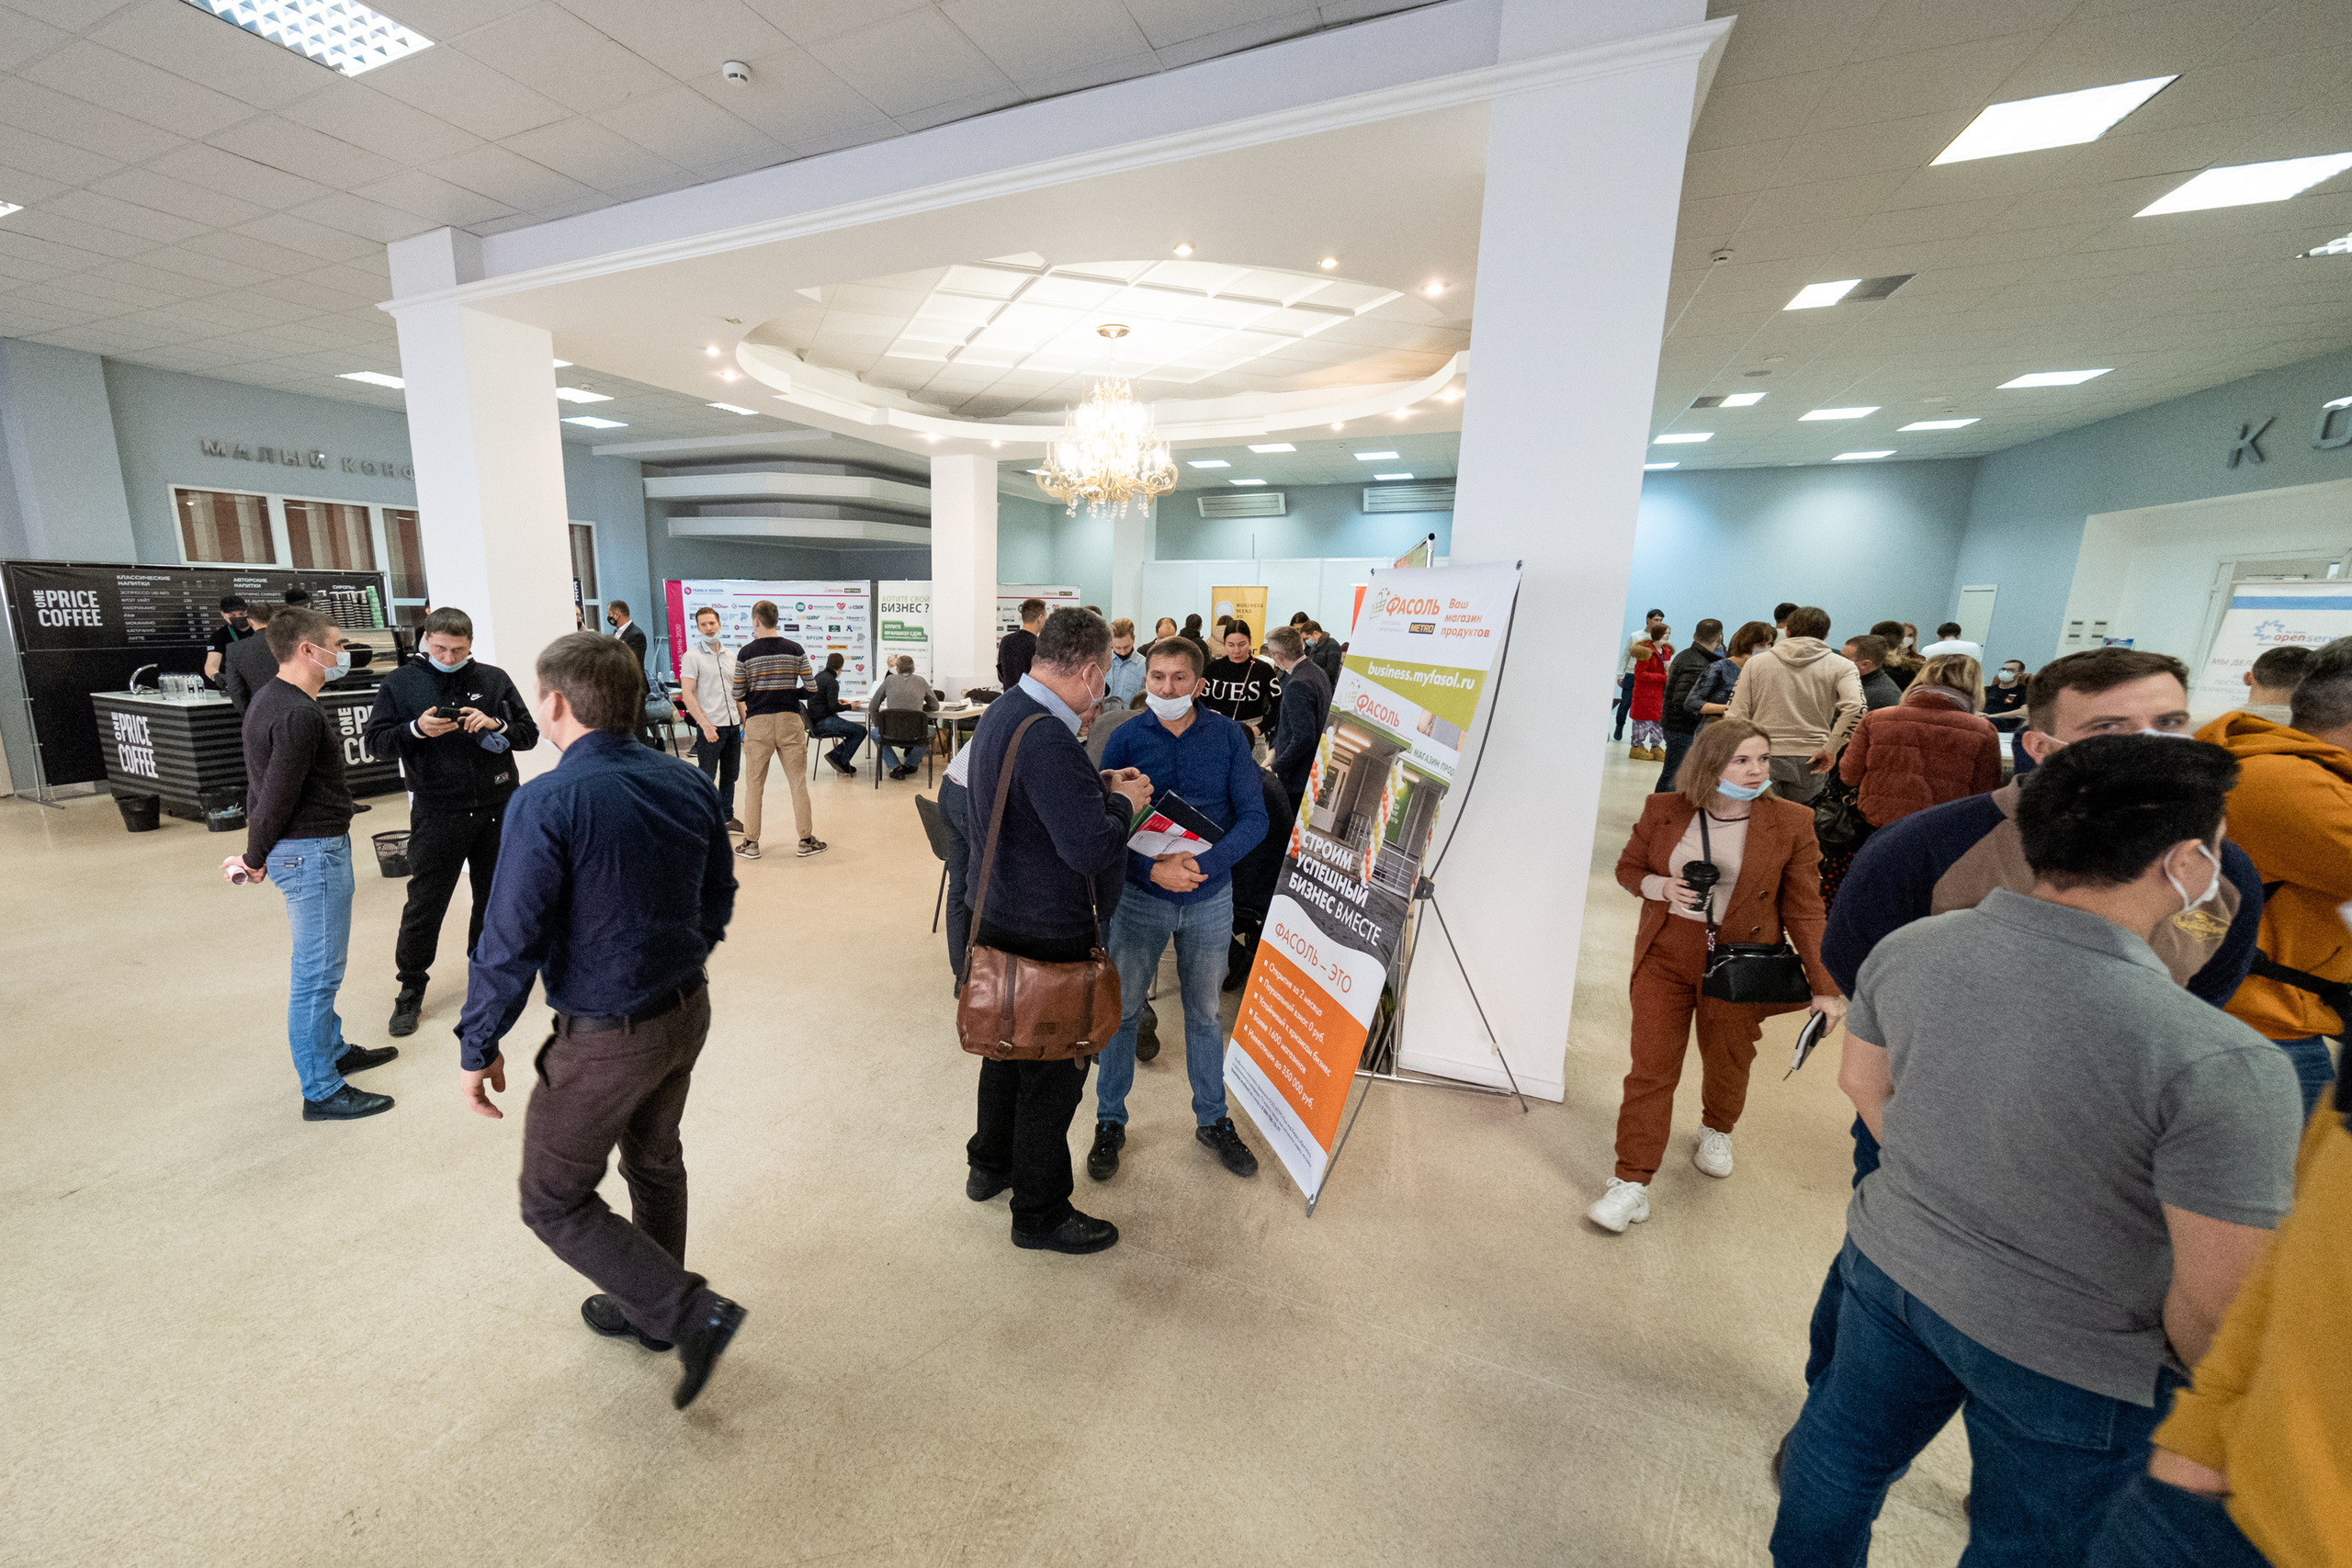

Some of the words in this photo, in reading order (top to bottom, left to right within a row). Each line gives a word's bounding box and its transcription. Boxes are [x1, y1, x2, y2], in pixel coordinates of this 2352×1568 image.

[200, 439, 325, 470] МАЛЫЙ
[32, 589, 47, 608] ONE
[45, 589, 100, 608] PRICE
[881, 603, 922, 613] БИЗНЕС
[924, 603, 930, 614] ?
[910, 594, 931, 603] СВОЙ
[1385, 595, 1441, 616] ФАСОЛЬ
[1448, 598, 1469, 609] Ваш
[38, 608, 103, 627] COFFEE
[1409, 623, 1435, 634] METRO
[1441, 626, 1490, 638] продуктов
[1444, 614, 1483, 624] магазин
[1367, 661, 1476, 690] business.myfasol.ru
[2211, 658, 2230, 667] МЫ
[337, 706, 354, 735] ONE
[1356, 694, 1400, 728] ФАСОЛЬ
[110, 712, 121, 741] ONE
[118, 712, 152, 747] PRICE
[118, 743, 159, 779] COFFEE
[1413, 748, 1441, 768] МАГАЗИН
[1303, 830, 1353, 871] СТРОИМ
[1295, 851, 1369, 908] УСПЕШНЫЙ
[1288, 873, 1336, 915] БИЗНЕС
[1335, 901, 1382, 947] ВМЕСТЕ
[1275, 922, 1318, 966] ФАСОЛЬ
[1328, 963, 1352, 994] ЭТО
[1269, 964, 1292, 989] Открытие
[1292, 987, 1299, 996] за
[1299, 988, 1305, 999] 2
[1303, 997, 1323, 1017] месяца
[1264, 979, 1295, 1012] Паушальный
[1294, 1010, 1308, 1029] взнос
[1312, 1029, 1325, 1044] руб.
[1253, 1010, 1268, 1032] Более
[1268, 1026, 1283, 1045] 1600
[1280, 1044, 1306, 1075] магазинов
[1259, 995, 1286, 1027] Устойчивый
[1288, 1028, 1312, 1056] кризисам
[1312, 1051, 1332, 1077] бизнес
[1248, 1028, 1275, 1063] Инвестиции
[1273, 1058, 1283, 1071] до
[1281, 1065, 1293, 1082] 350
[1292, 1078, 1303, 1095] 000
[1301, 1092, 1314, 1110] руб.
